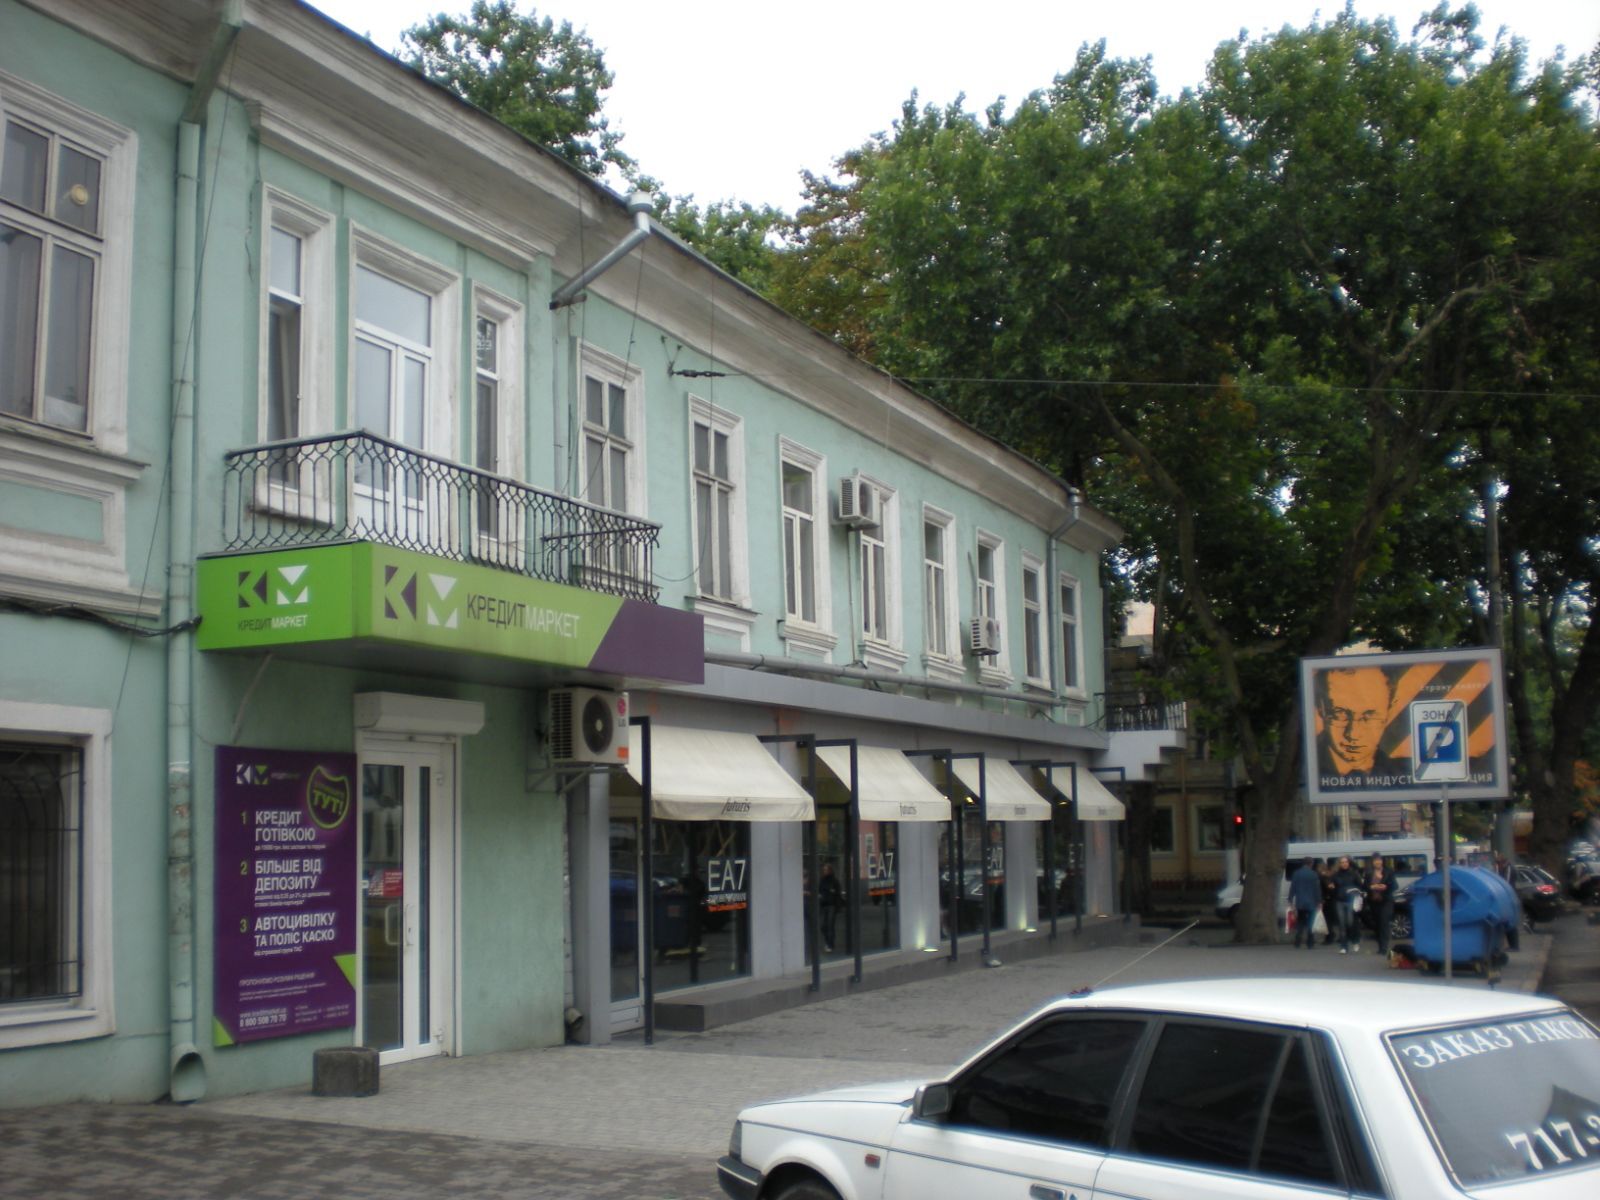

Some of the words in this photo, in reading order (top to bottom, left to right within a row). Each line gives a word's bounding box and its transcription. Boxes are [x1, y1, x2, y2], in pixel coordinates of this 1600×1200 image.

[238, 614, 308, 631] КРЕДИТМАРКЕТ
[467, 593, 580, 638] КРЕДИТМАРКЕТ
[1422, 709, 1455, 721] ЗОНА
[1321, 776, 1362, 787] НОВАЯ
[240, 811, 247, 825] 1
[255, 810, 302, 827] КРЕДИТ
[255, 827, 316, 842] ГОТІВКОЮ
[240, 861, 248, 875] 2
[255, 860, 300, 875] БІЛЬШЕ
[302, 858, 322, 875] ВІД
[868, 852, 894, 879] EA7
[255, 875, 318, 894] ДЕПОЗИТУ
[708, 859, 746, 892] EA7
[240, 918, 247, 933] 3
[254, 912, 335, 931] АВТОЦИВІЛКУ
[254, 934, 268, 947] ТА
[269, 931, 300, 946] ПОЛІС
[302, 928, 335, 943] КАСКО
[1402, 1027, 1514, 1068] ЗАКАЗ
[1507, 1020, 1600, 1044] ТАКСИ
